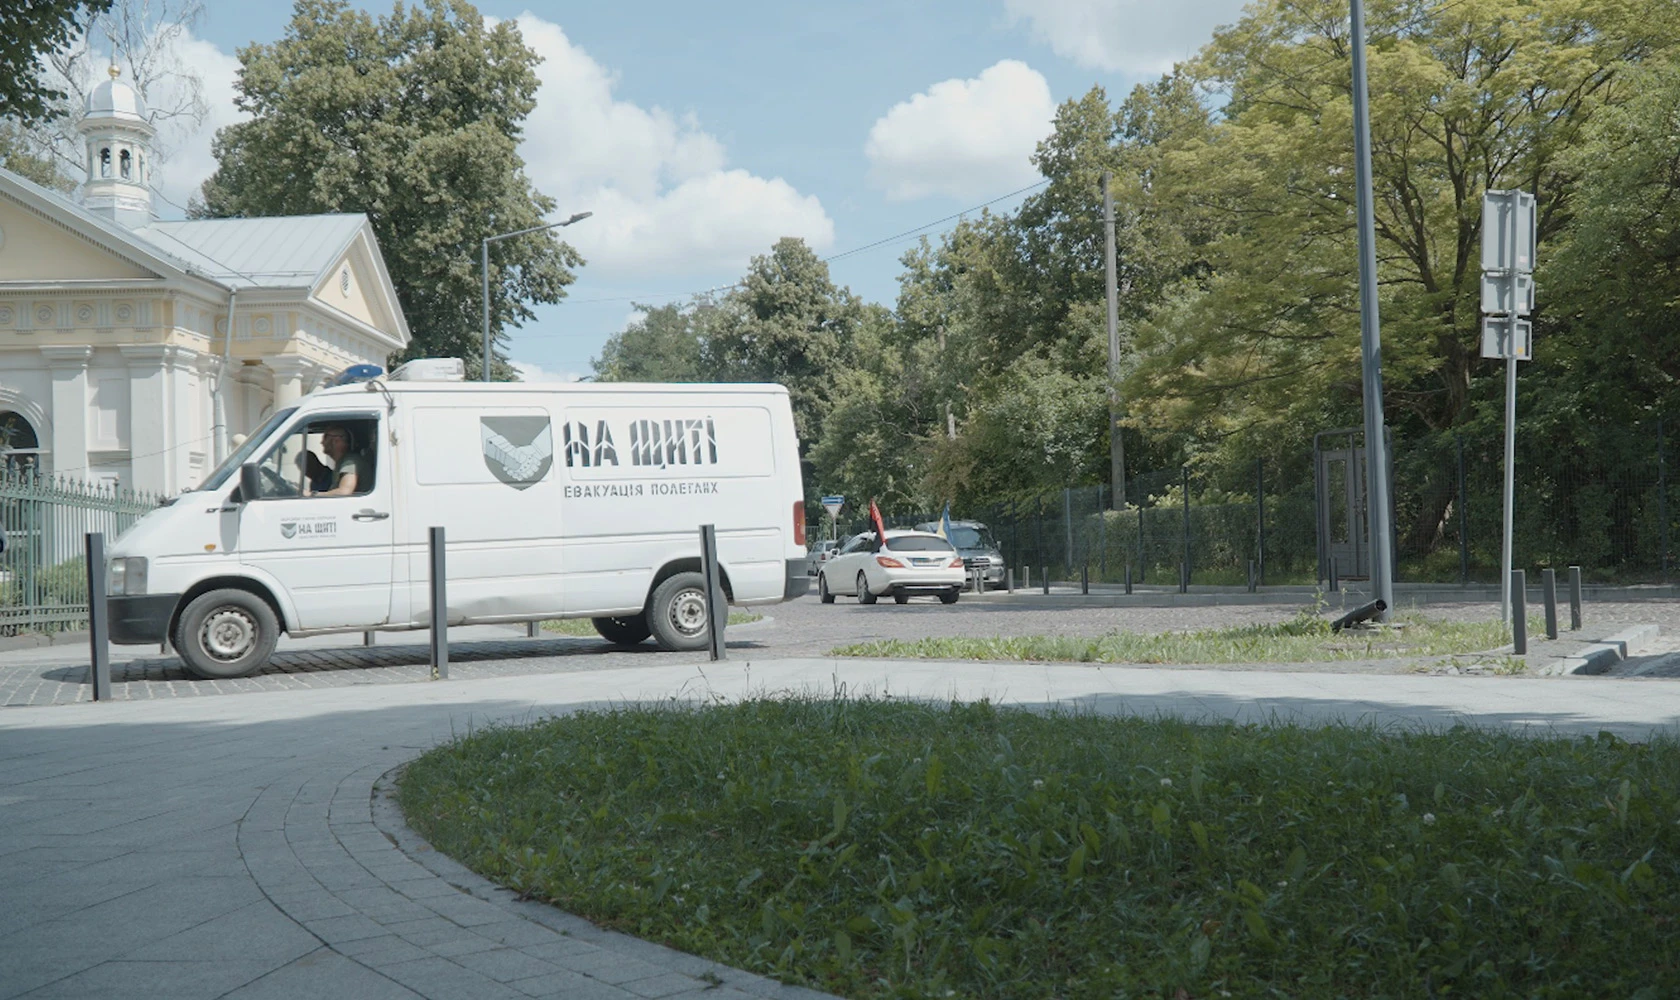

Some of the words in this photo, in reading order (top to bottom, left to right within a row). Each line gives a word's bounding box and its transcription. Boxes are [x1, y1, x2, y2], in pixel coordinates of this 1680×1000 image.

[563, 420, 619, 467] НА
[629, 415, 718, 470] ЩИТІ
[564, 484, 644, 498] ЕВАКУАЦІЯ
[651, 481, 719, 496] ПОЛЕГЛИХ
[298, 523, 312, 534] НА
